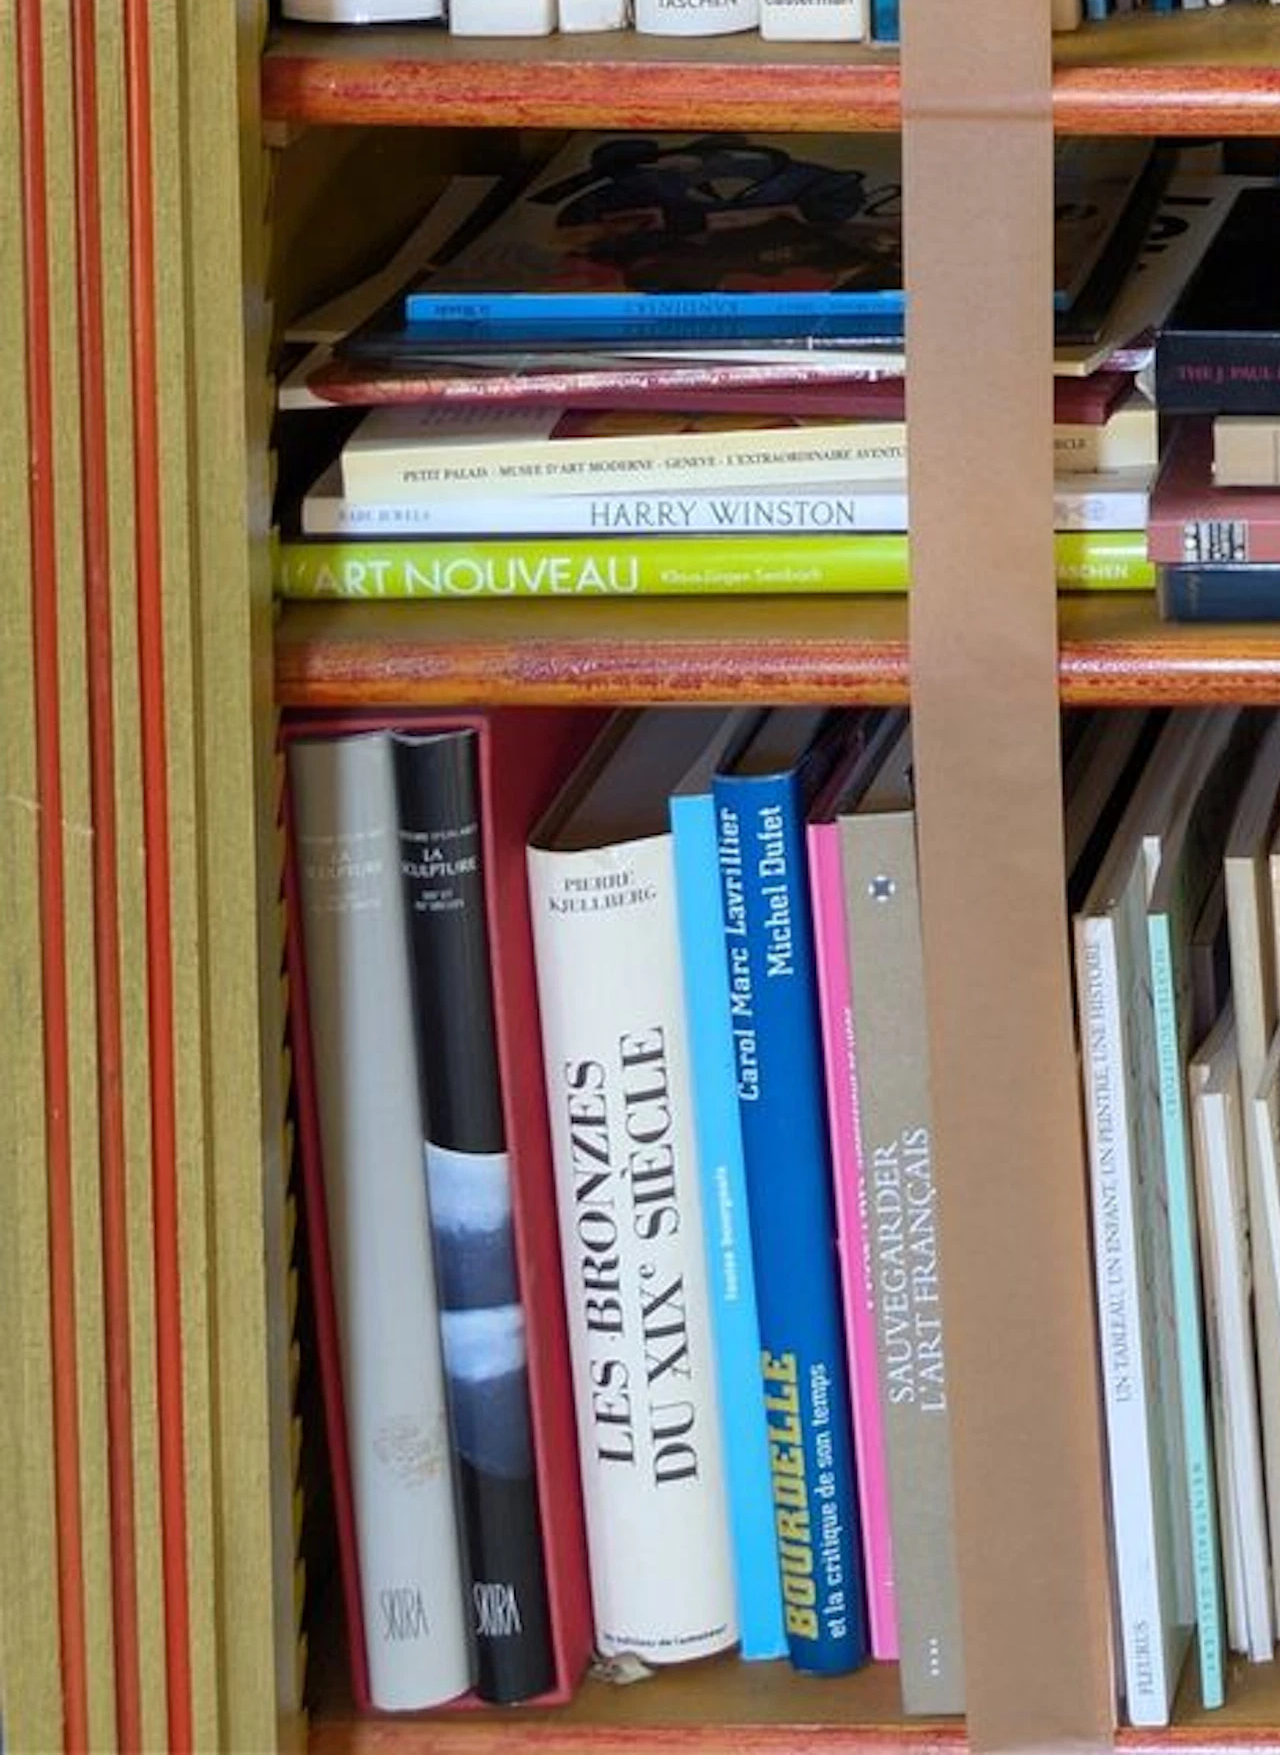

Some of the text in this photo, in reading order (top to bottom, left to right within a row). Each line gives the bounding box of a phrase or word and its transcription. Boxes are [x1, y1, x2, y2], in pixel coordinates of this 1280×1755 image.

[404, 556, 641, 596] NOUVEAU
[588, 498, 857, 529] HARRY WINSTON
[547, 885, 658, 914] KJELLBERG
[756, 804, 794, 979] Michel Dufet
[566, 1056, 638, 1467] LES BRONZES
[619, 1024, 698, 1486] DU SIÈCLE
[760, 1349, 820, 1641] BOURDELLE
